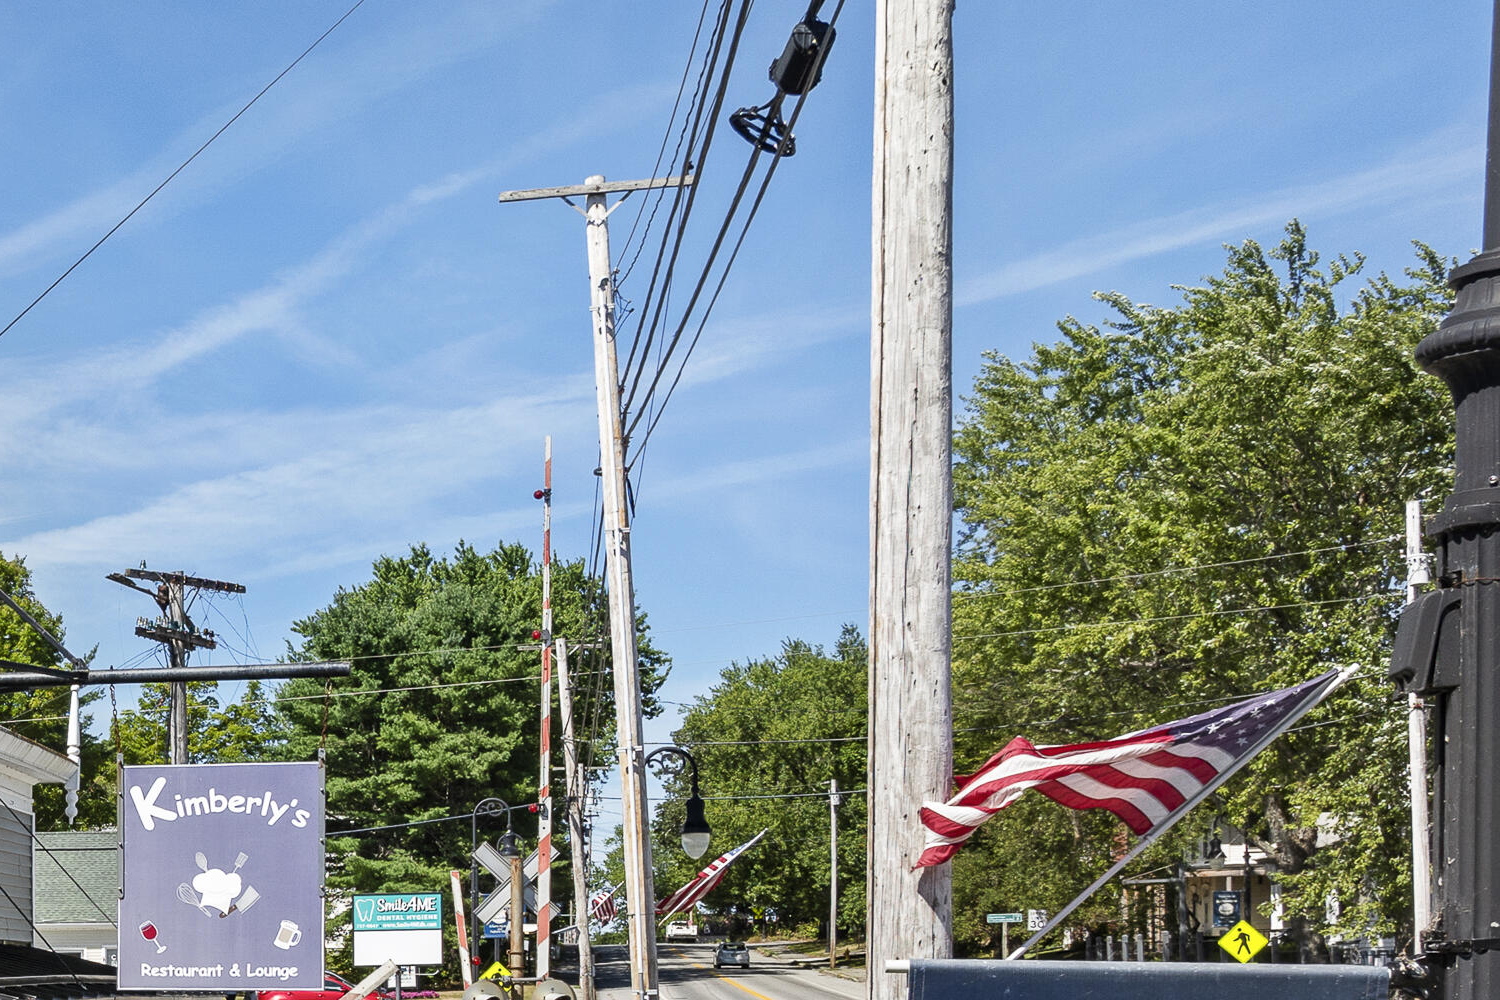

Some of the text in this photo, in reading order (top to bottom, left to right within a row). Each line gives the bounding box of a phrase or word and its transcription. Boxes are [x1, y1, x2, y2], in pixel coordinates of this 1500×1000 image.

[129, 776, 311, 831] Kimberly's
[406, 913, 438, 921] HYGIENE
[1030, 920, 1045, 929] 30
[140, 962, 299, 981] Restaurant & Lounge
